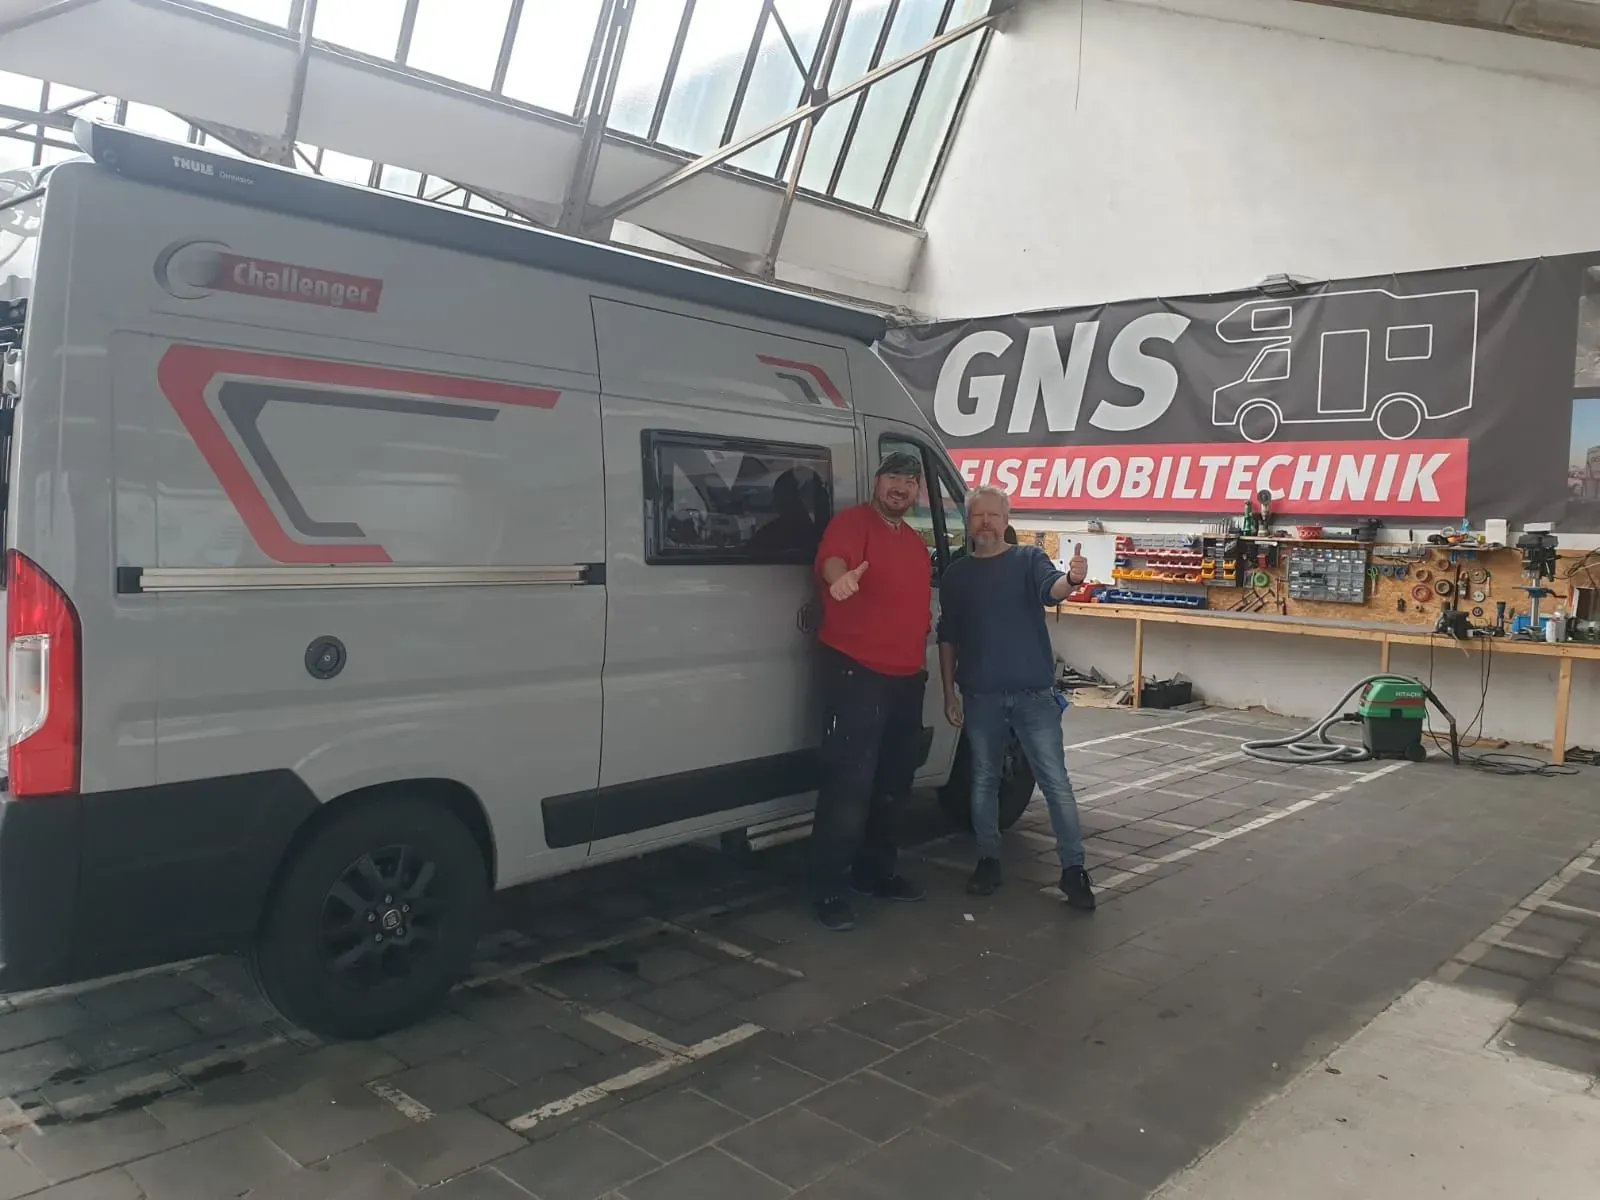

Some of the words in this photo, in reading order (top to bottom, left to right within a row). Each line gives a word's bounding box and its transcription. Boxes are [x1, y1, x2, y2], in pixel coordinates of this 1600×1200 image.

[172, 156, 214, 176] THULE
[233, 261, 372, 306] Challenger
[933, 312, 1192, 437] GNS
[958, 452, 1451, 502] EISEMOBILTECHNIK
